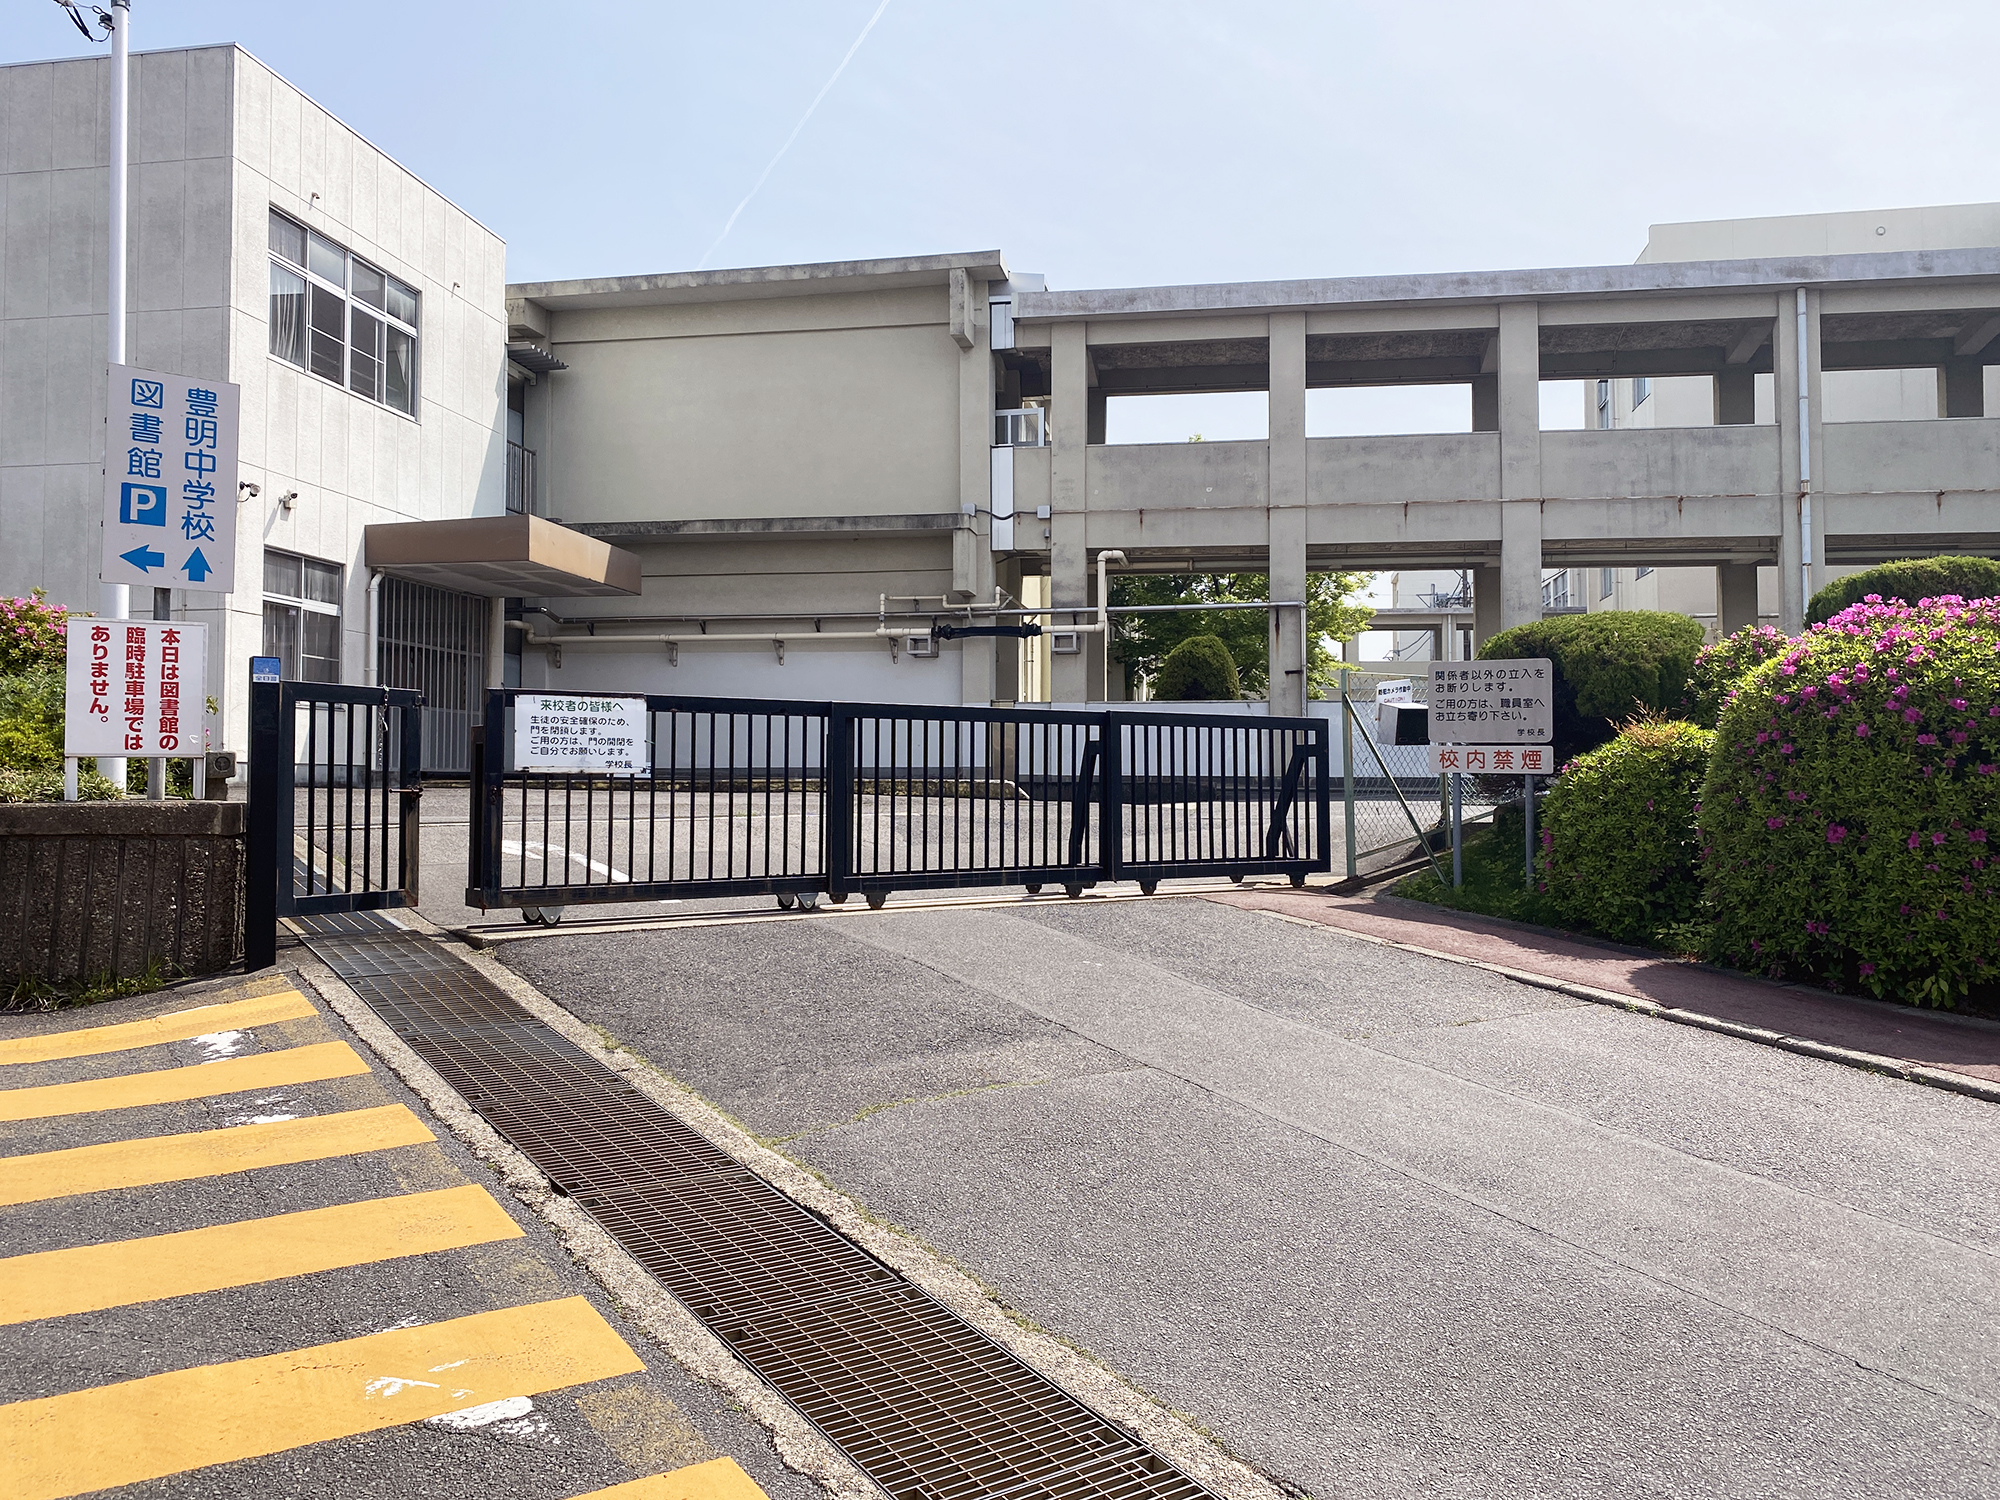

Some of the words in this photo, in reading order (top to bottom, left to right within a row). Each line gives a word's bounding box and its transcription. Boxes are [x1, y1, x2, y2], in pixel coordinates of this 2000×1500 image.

[126, 378, 164, 479] 図書館
[180, 387, 219, 542] 豊明中学校
[129, 487, 157, 521] P
[88, 625, 111, 723] ありません。
[1435, 668, 1545, 681] 関係者以外の立入を
[123, 626, 147, 751] 臨時駐車場では
[158, 628, 181, 751] 本日は図書館の
[1435, 682, 1513, 693] お断りします。
[540, 698, 624, 713] 来校者の皆様へ
[1435, 698, 1545, 709] ご用の方は、職員室へ
[530, 715, 630, 727] 生徒の安全確保のため、
[1435, 711, 1527, 722] お立ち寄り下さい。
[530, 726, 602, 736] 門を閉鎖します。
[1516, 728, 1546, 737] 学校長
[530, 736, 634, 747] ご用の方は、門の開閉を
[530, 746, 630, 757] ご自分でお願いします。
[604, 760, 633, 769] 学校長
[1439, 749, 1543, 770] 校内禁煙
